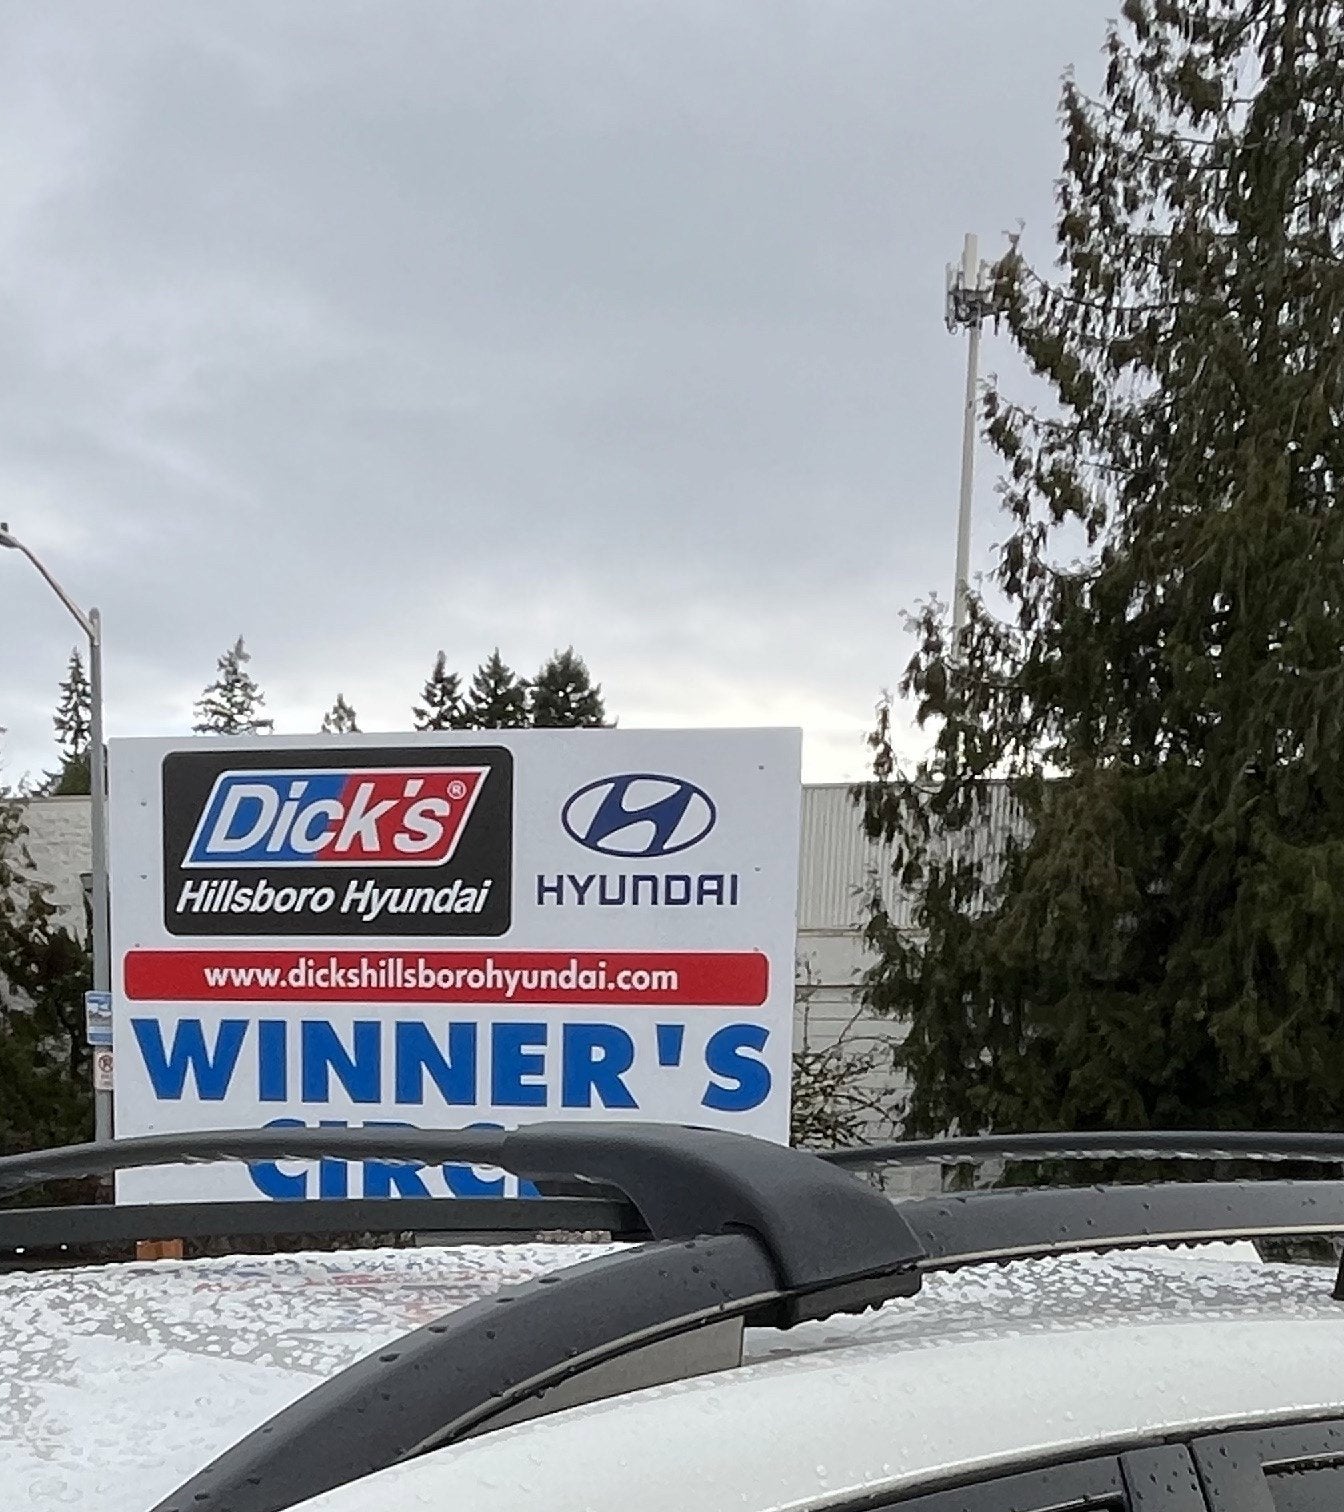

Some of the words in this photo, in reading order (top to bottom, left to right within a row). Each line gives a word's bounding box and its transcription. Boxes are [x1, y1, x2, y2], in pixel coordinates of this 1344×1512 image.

[175, 880, 336, 914] Hillsboro
[340, 880, 492, 922] Hyundai
[536, 874, 738, 907] HYUNDAI
[203, 958, 679, 995] www.dickshillsborohyundai.com
[130, 1019, 772, 1112] WINNER'S
